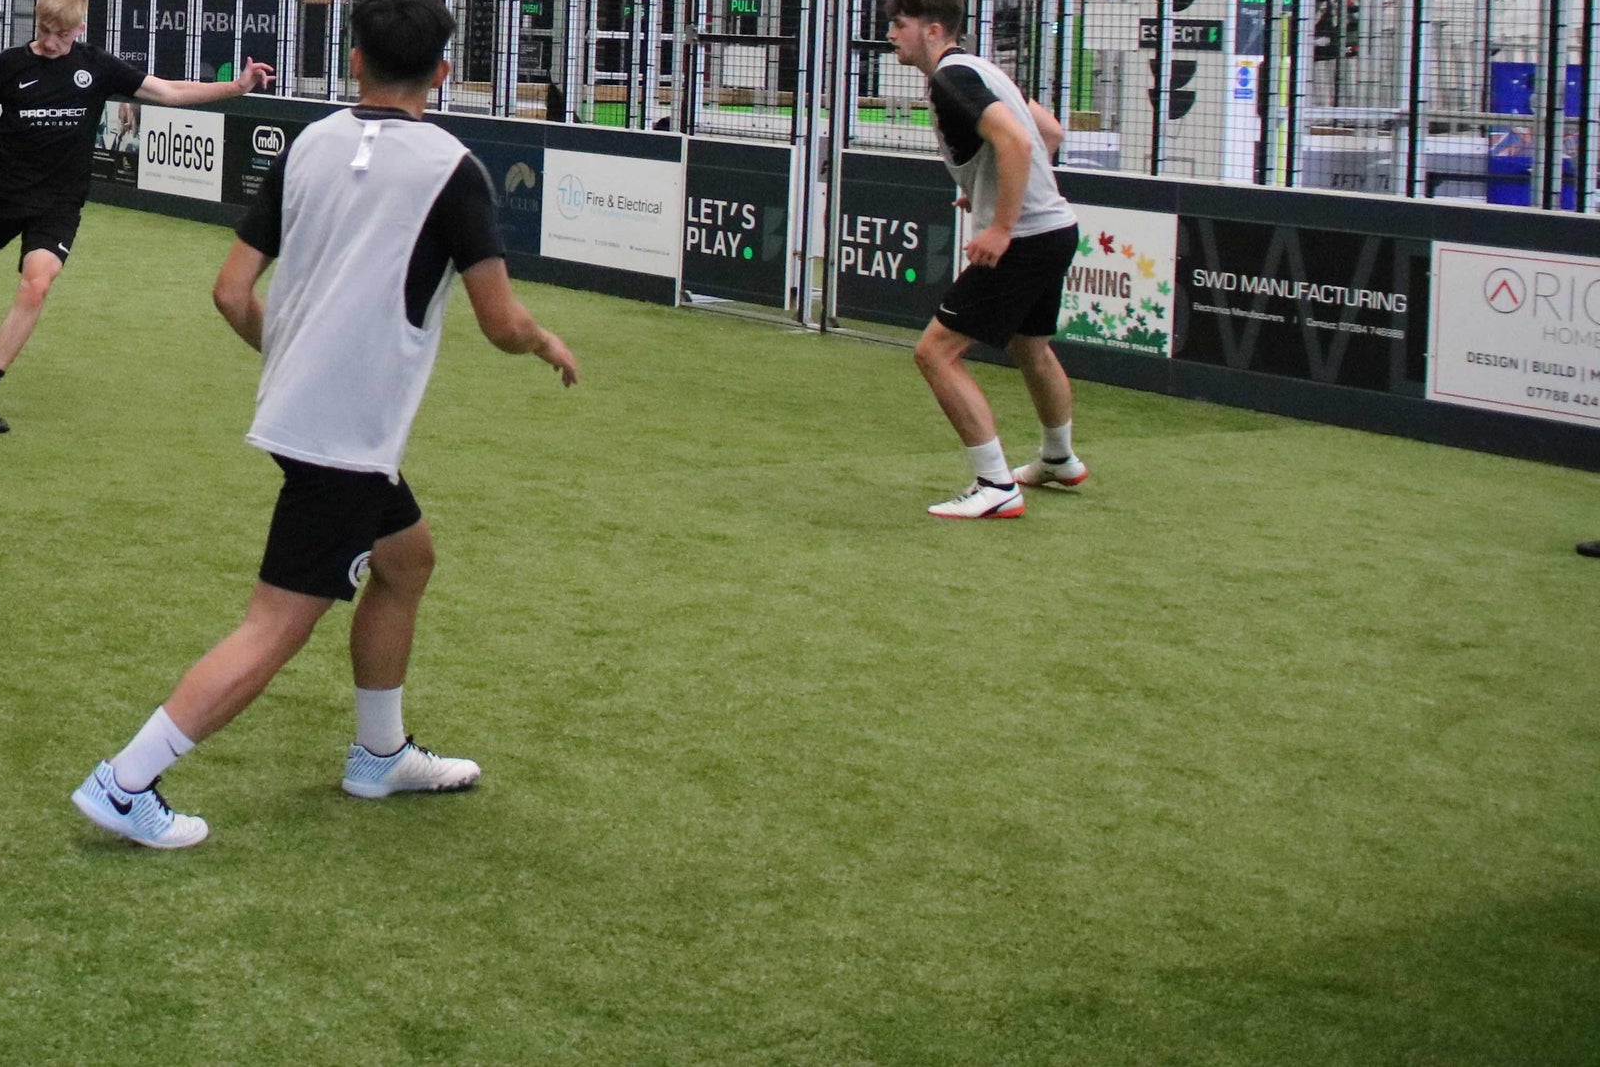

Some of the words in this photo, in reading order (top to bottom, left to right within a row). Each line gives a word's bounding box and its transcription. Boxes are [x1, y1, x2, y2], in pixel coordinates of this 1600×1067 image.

[731, 0, 758, 13] PULL
[258, 129, 279, 151] mdh
[586, 191, 604, 207] Fire
[608, 195, 615, 207] &
[617, 195, 663, 215] Electrical
[688, 196, 755, 230] LET'S
[842, 214, 919, 250] LET'S
[1066, 265, 1131, 298] WNING
[1193, 269, 1236, 290] SWD
[1240, 275, 1407, 313] MANUFACTURING
[1063, 294, 1079, 310] ES
[1467, 351, 1518, 369] DESIGN
[1532, 361, 1576, 378] BUILD
[1526, 386, 1569, 402] 07788
[1572, 393, 1599, 406] 424
